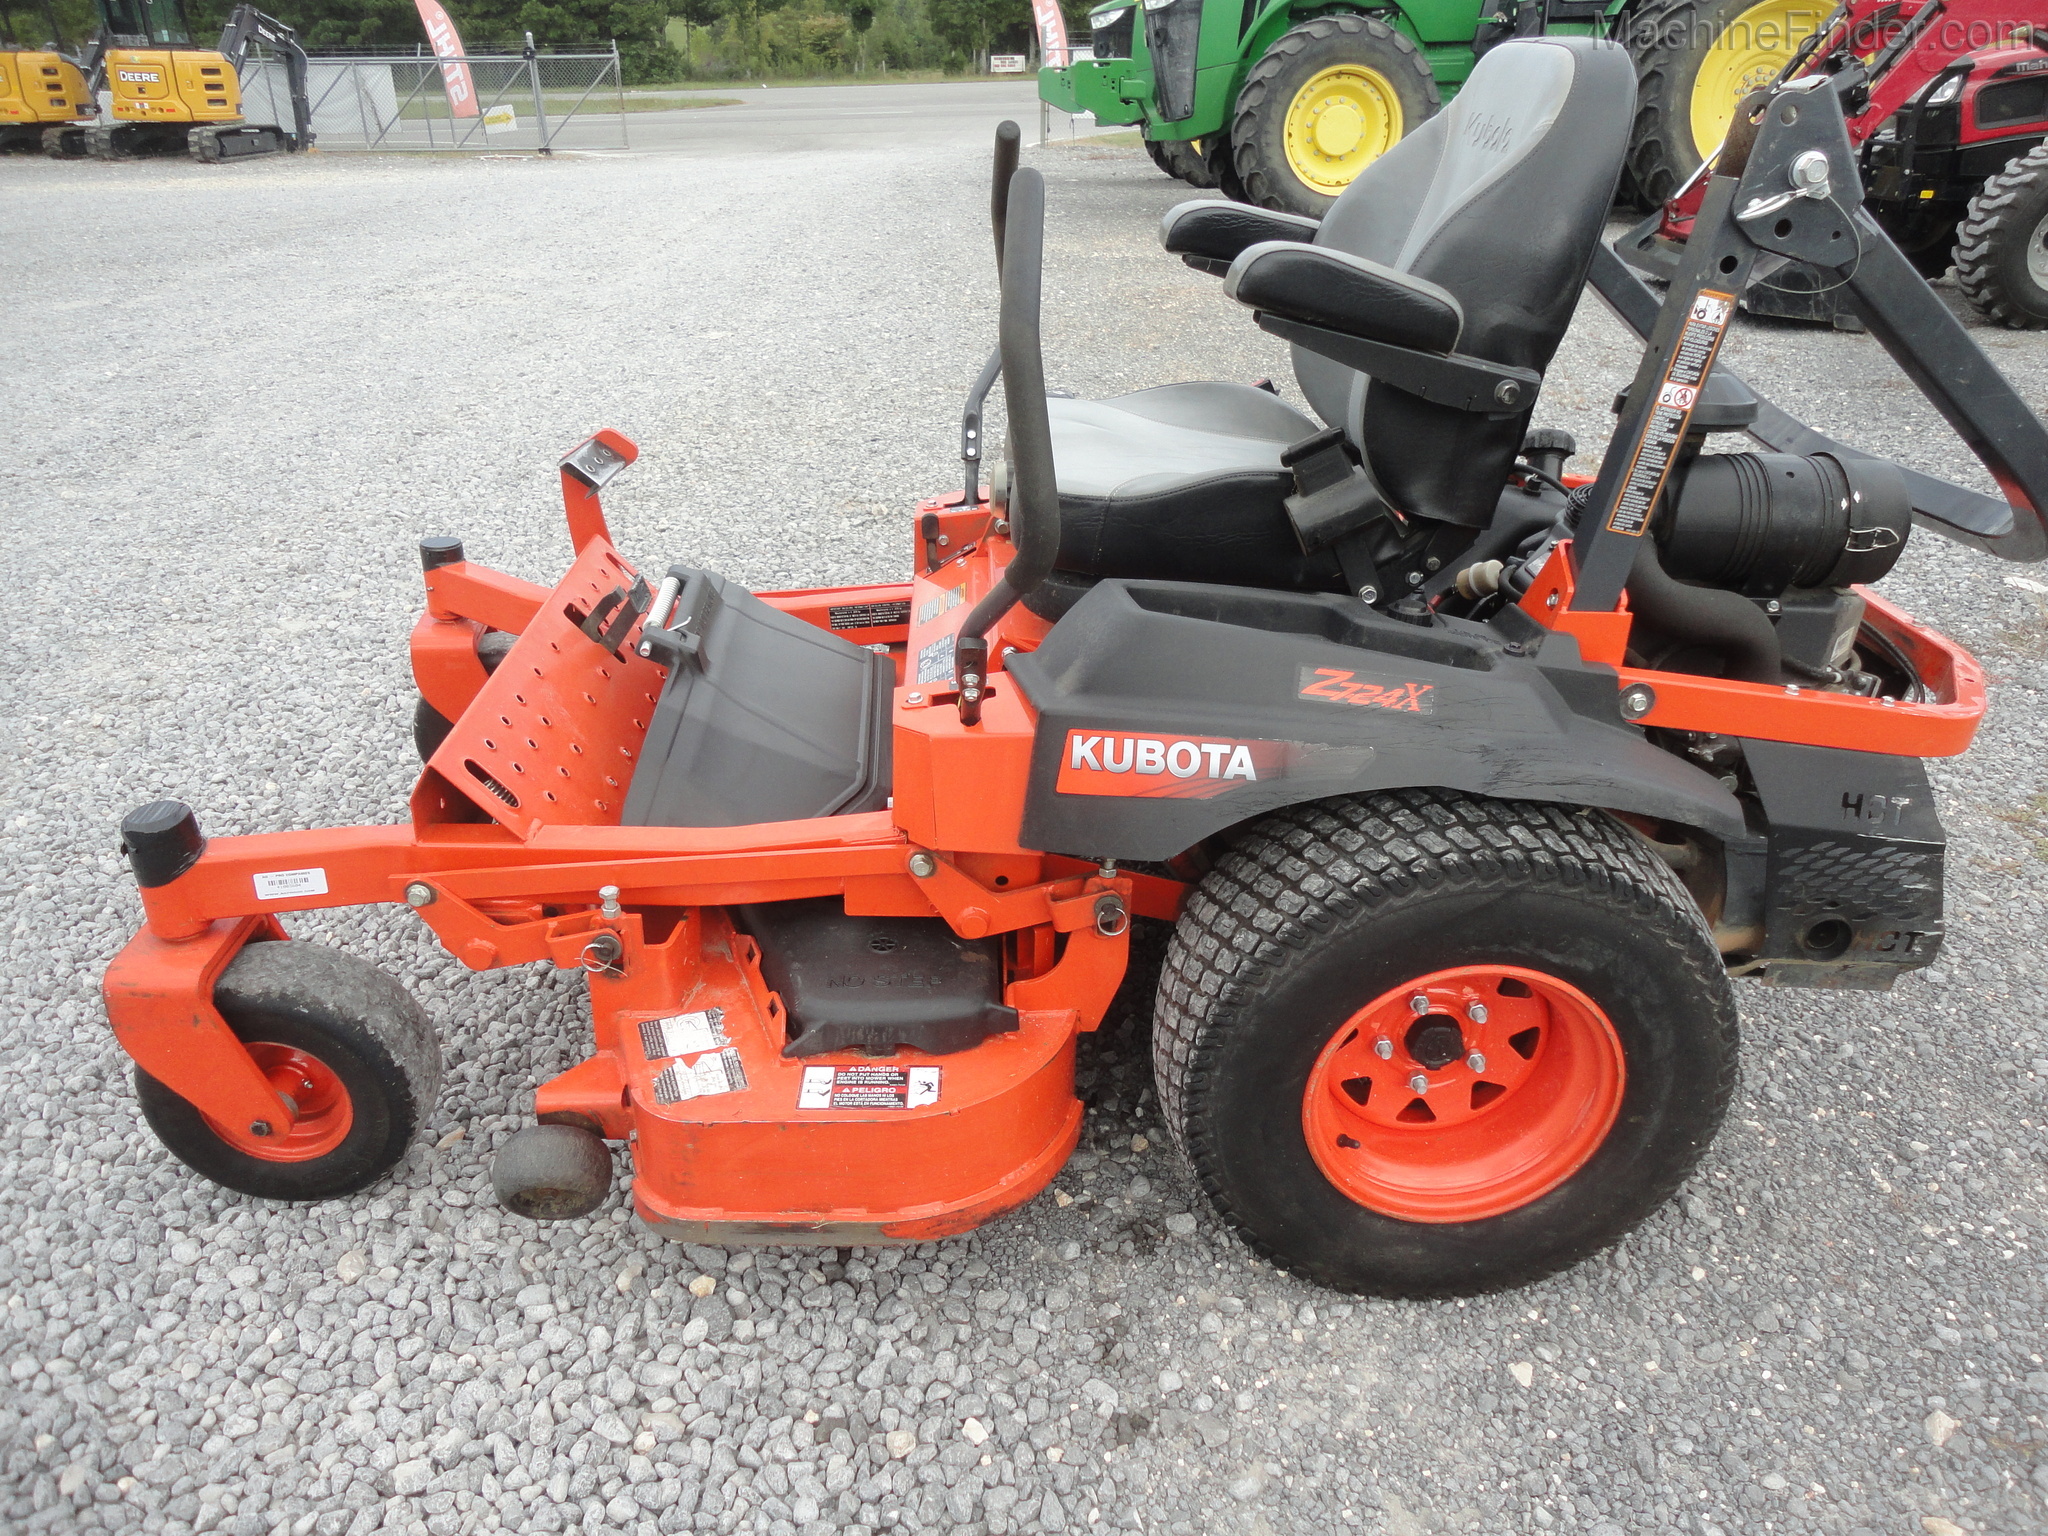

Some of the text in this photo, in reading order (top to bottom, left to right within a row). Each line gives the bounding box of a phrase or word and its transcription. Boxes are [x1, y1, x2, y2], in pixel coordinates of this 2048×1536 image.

[257, 24, 277, 43] DEERE
[119, 70, 160, 83] DEERE
[1301, 667, 1434, 712] Z724X
[1070, 734, 1257, 781] KUBOTA
[873, 971, 943, 990] STEP
